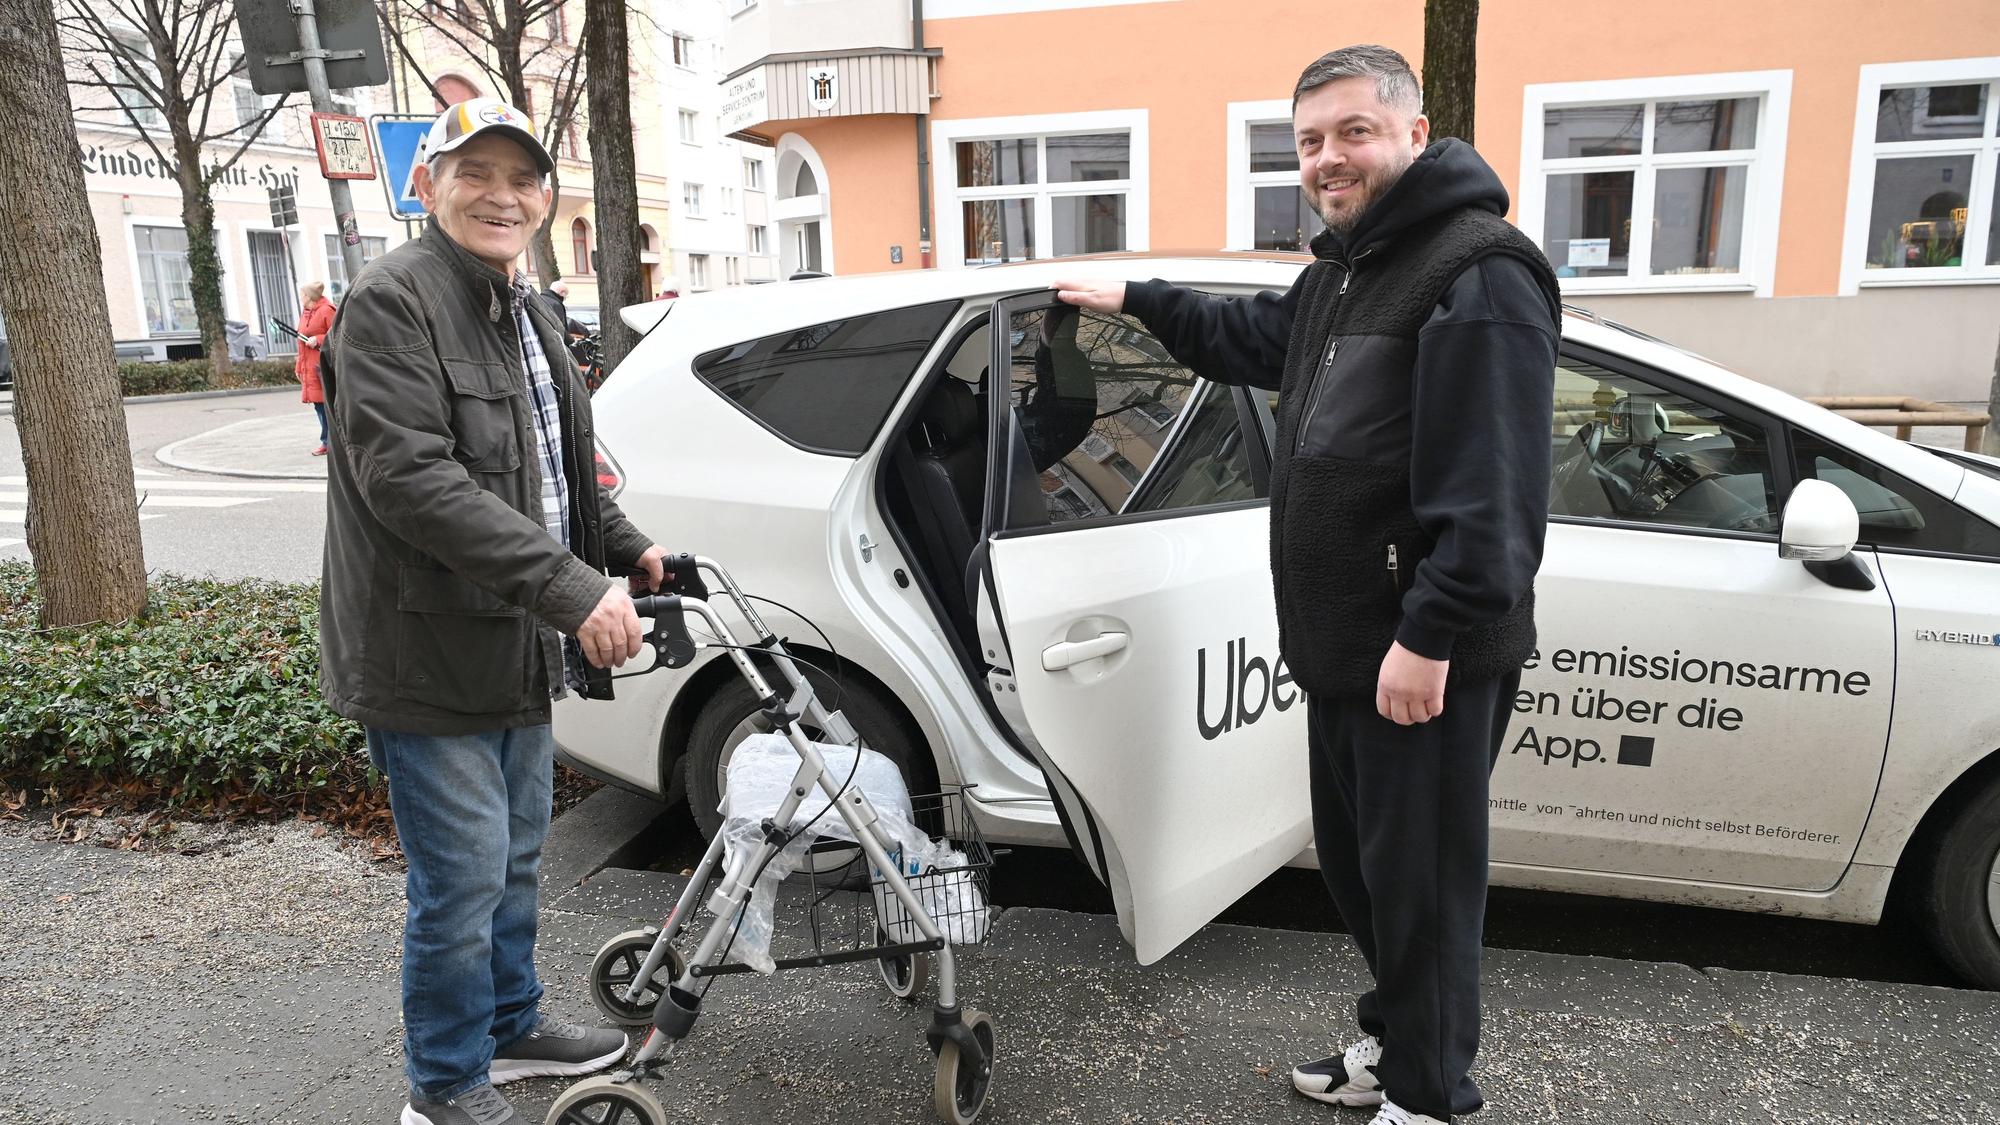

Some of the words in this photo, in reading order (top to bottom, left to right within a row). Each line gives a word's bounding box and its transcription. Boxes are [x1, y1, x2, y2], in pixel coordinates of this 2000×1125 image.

[322, 121, 331, 137] H
[337, 121, 357, 137] 150
[1916, 627, 1992, 646] HYBRID
[1552, 645, 1871, 696] emissionsarme
[1571, 687, 1669, 725] über
[1677, 697, 1744, 731] die
[1511, 726, 1607, 769] App.
[1536, 804, 1563, 815] von
[1568, 804, 1625, 822] ahrten
[1629, 813, 1658, 825] und
[1662, 815, 1702, 830] nicht
[1705, 820, 1751, 835] selbst
[1755, 824, 1841, 845] Beförderer.
